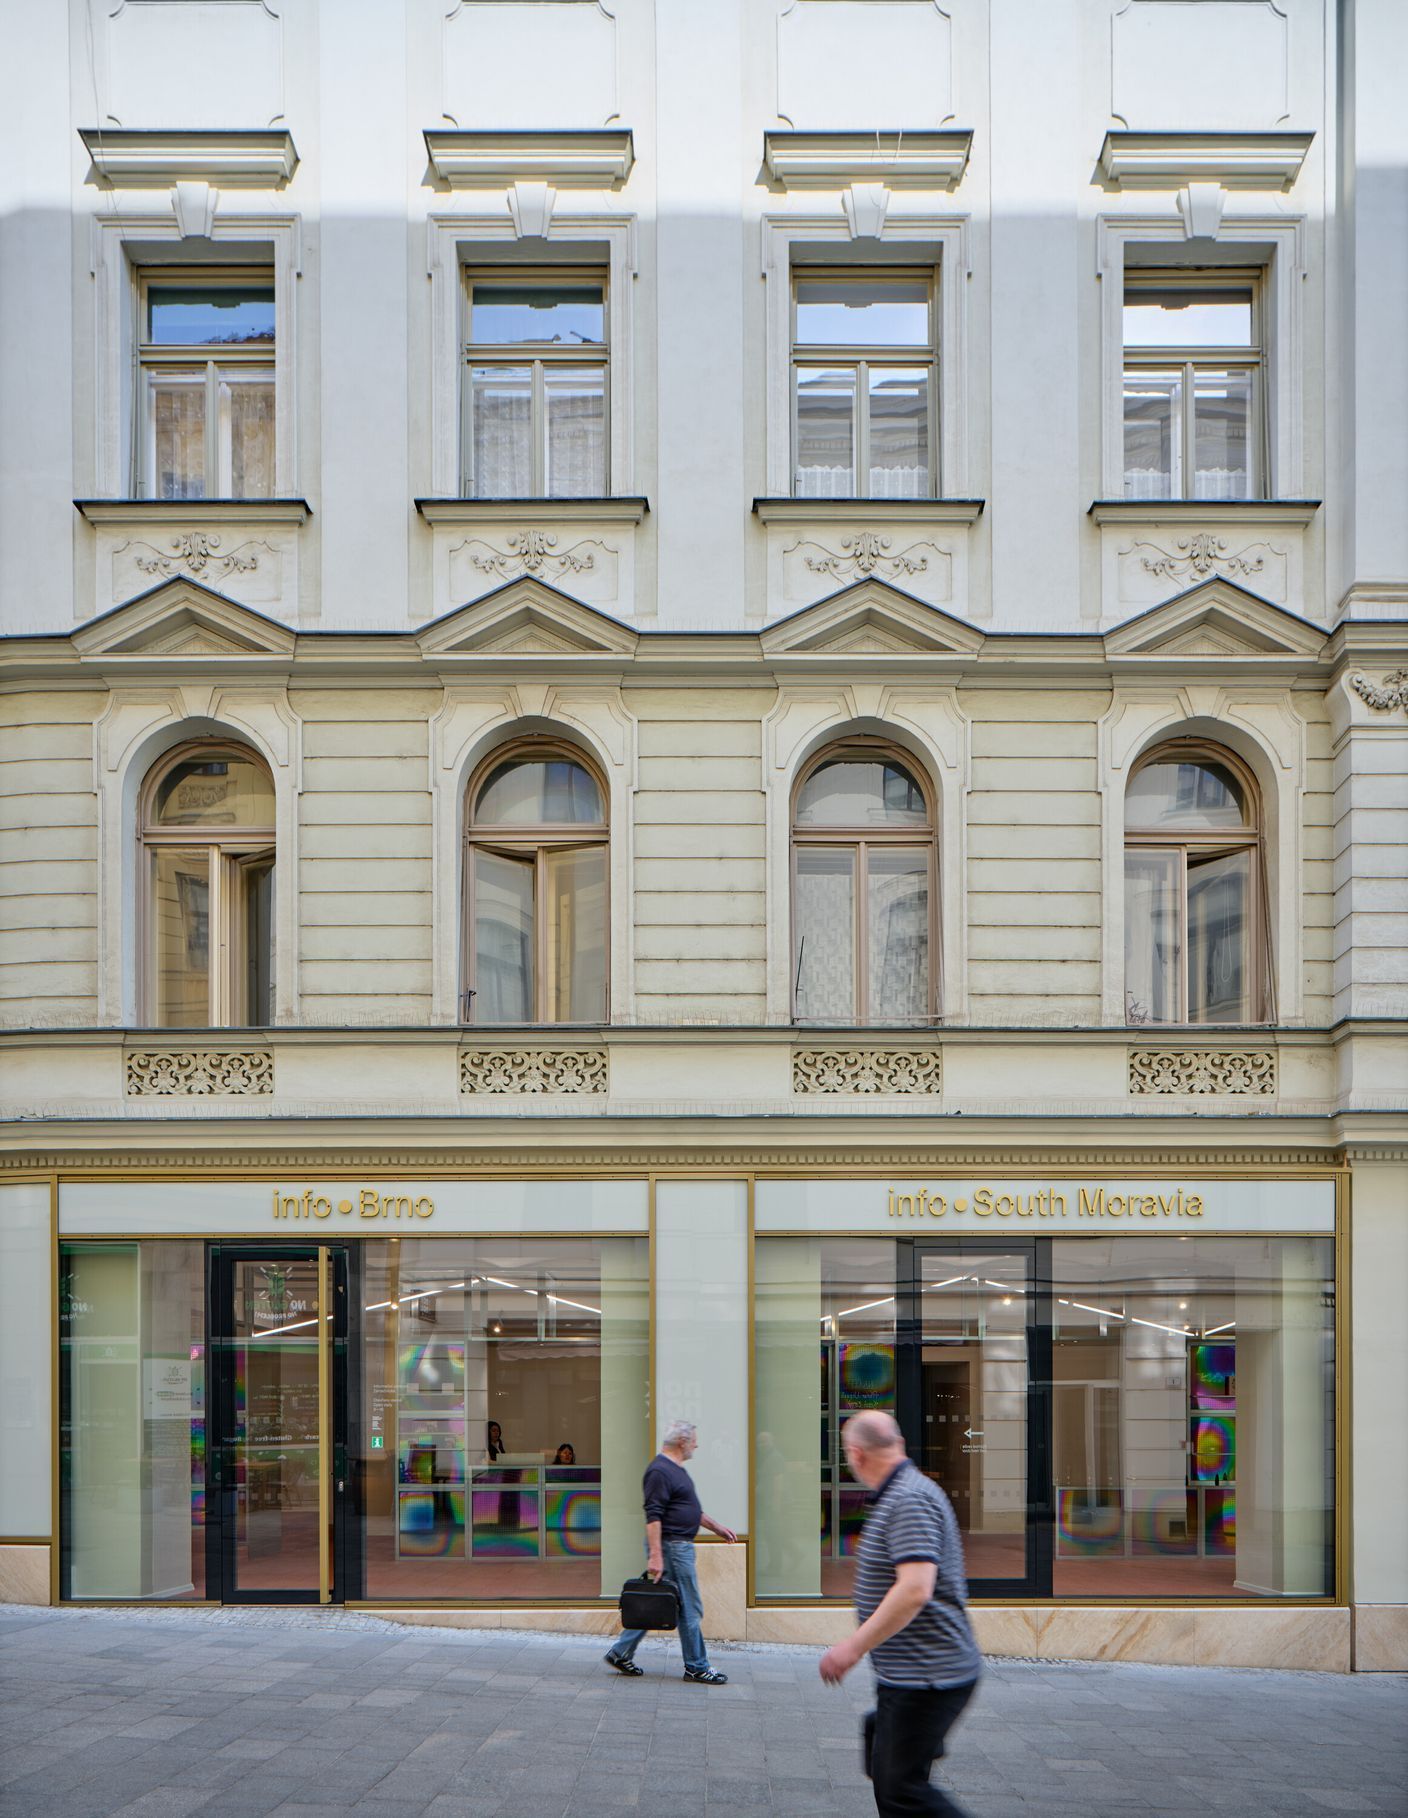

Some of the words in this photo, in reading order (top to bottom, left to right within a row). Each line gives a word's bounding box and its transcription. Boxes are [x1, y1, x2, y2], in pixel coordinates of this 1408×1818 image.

[273, 1189, 332, 1218] info
[360, 1189, 434, 1218] Brno
[888, 1187, 948, 1217] info
[973, 1187, 1067, 1217] South
[1078, 1187, 1205, 1217] Moravia
